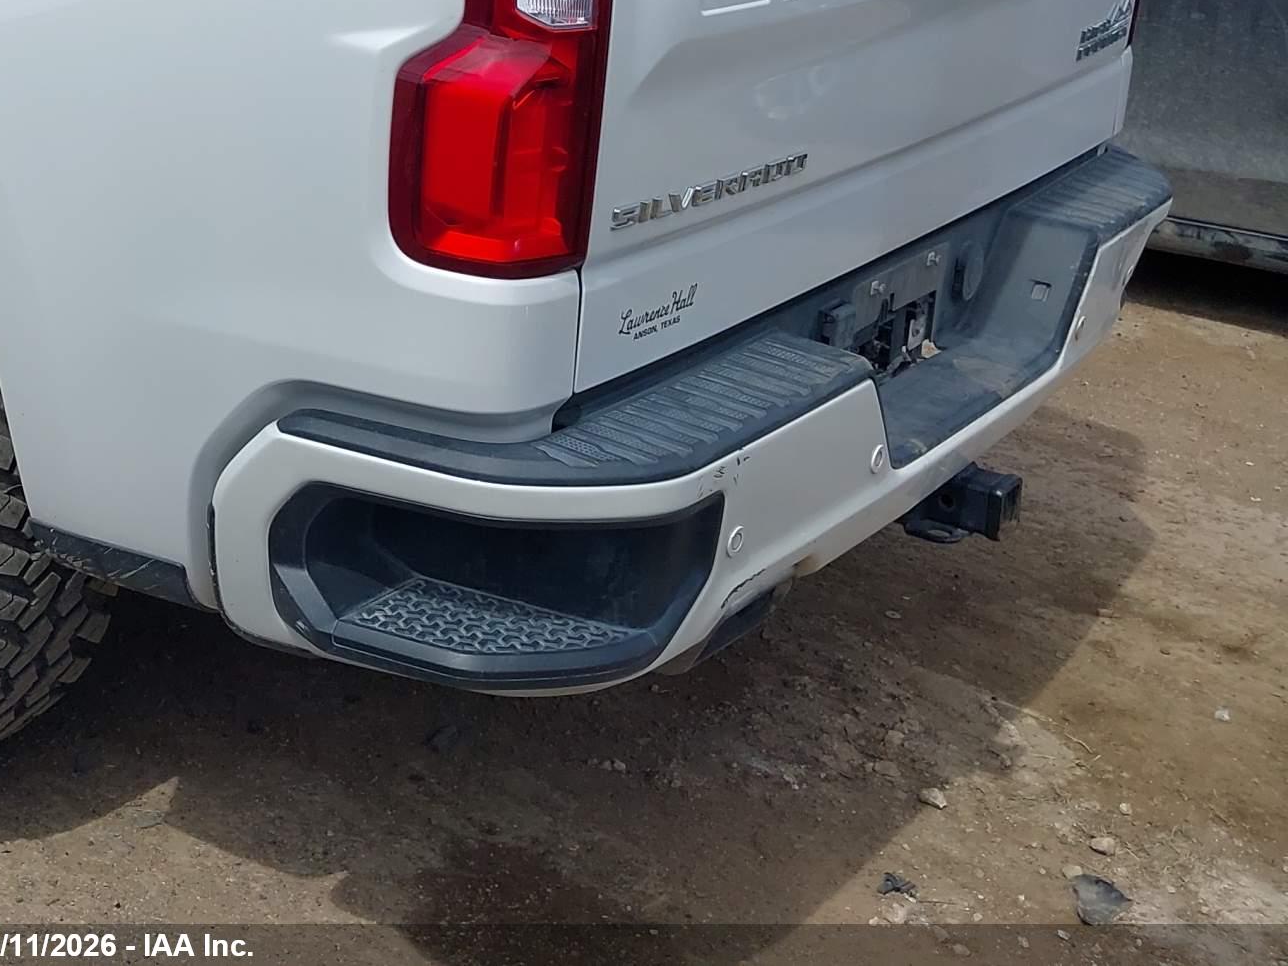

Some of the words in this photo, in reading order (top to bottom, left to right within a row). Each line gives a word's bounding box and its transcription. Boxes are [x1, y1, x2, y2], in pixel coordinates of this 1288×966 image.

[618, 304, 670, 335] Lawrence
[671, 282, 698, 314] Hall
[660, 315, 681, 329] TEXAS
